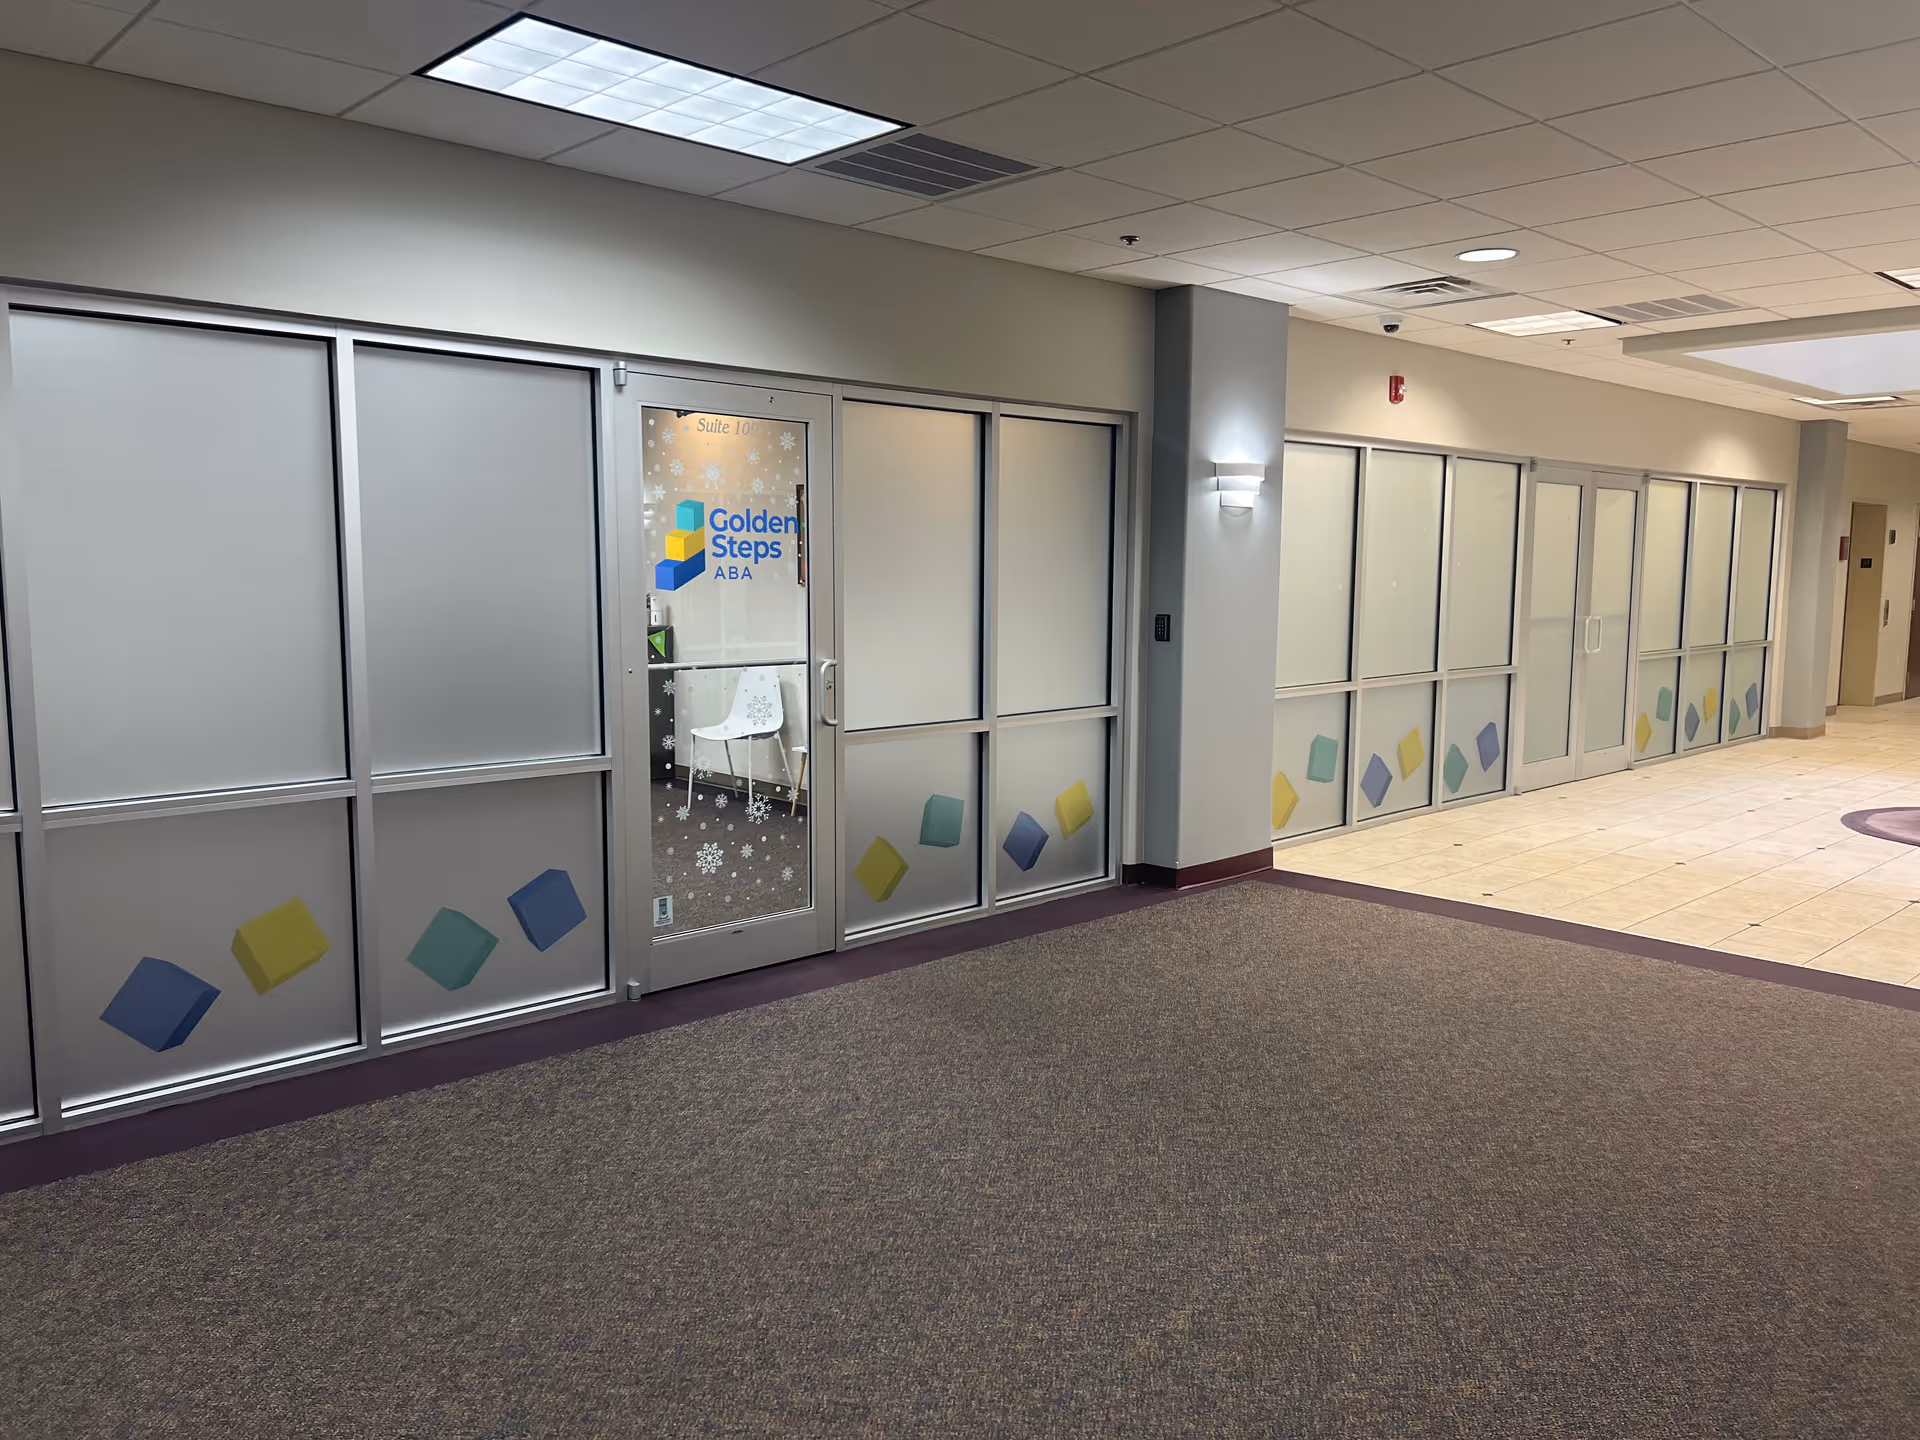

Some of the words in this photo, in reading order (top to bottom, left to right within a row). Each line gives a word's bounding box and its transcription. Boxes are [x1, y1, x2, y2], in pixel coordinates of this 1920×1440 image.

[697, 418, 730, 434] Suite
[709, 508, 798, 534] Golden
[712, 534, 782, 564] Steps
[714, 566, 752, 579] ABA
